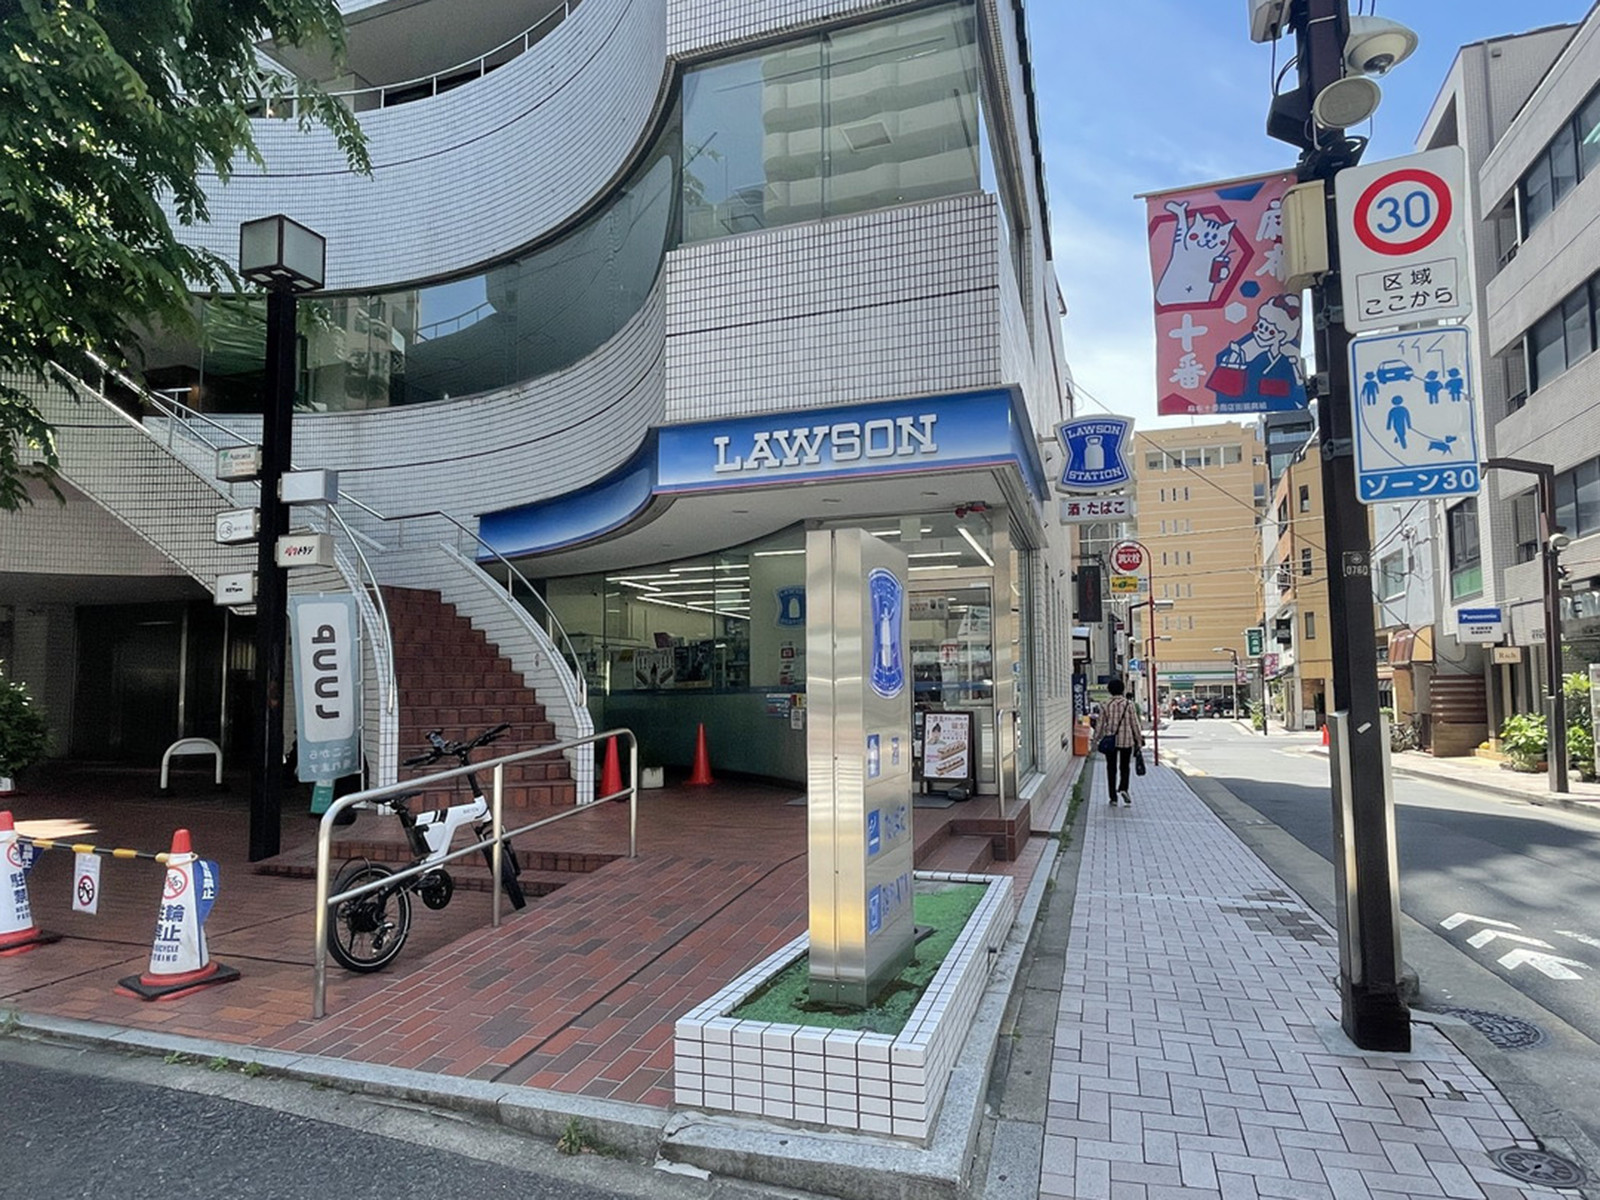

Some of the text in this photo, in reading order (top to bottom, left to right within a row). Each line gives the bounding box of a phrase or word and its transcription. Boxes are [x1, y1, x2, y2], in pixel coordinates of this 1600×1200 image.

[1376, 190, 1431, 234] 30
[1383, 268, 1432, 291] 区域
[1365, 287, 1453, 316] ここから
[1168, 313, 1208, 390] 十番
[714, 414, 937, 472] LAWSON
[1067, 425, 1121, 438] LAWSON
[1069, 467, 1122, 480] STATION
[1366, 469, 1474, 497] ゾーン30
